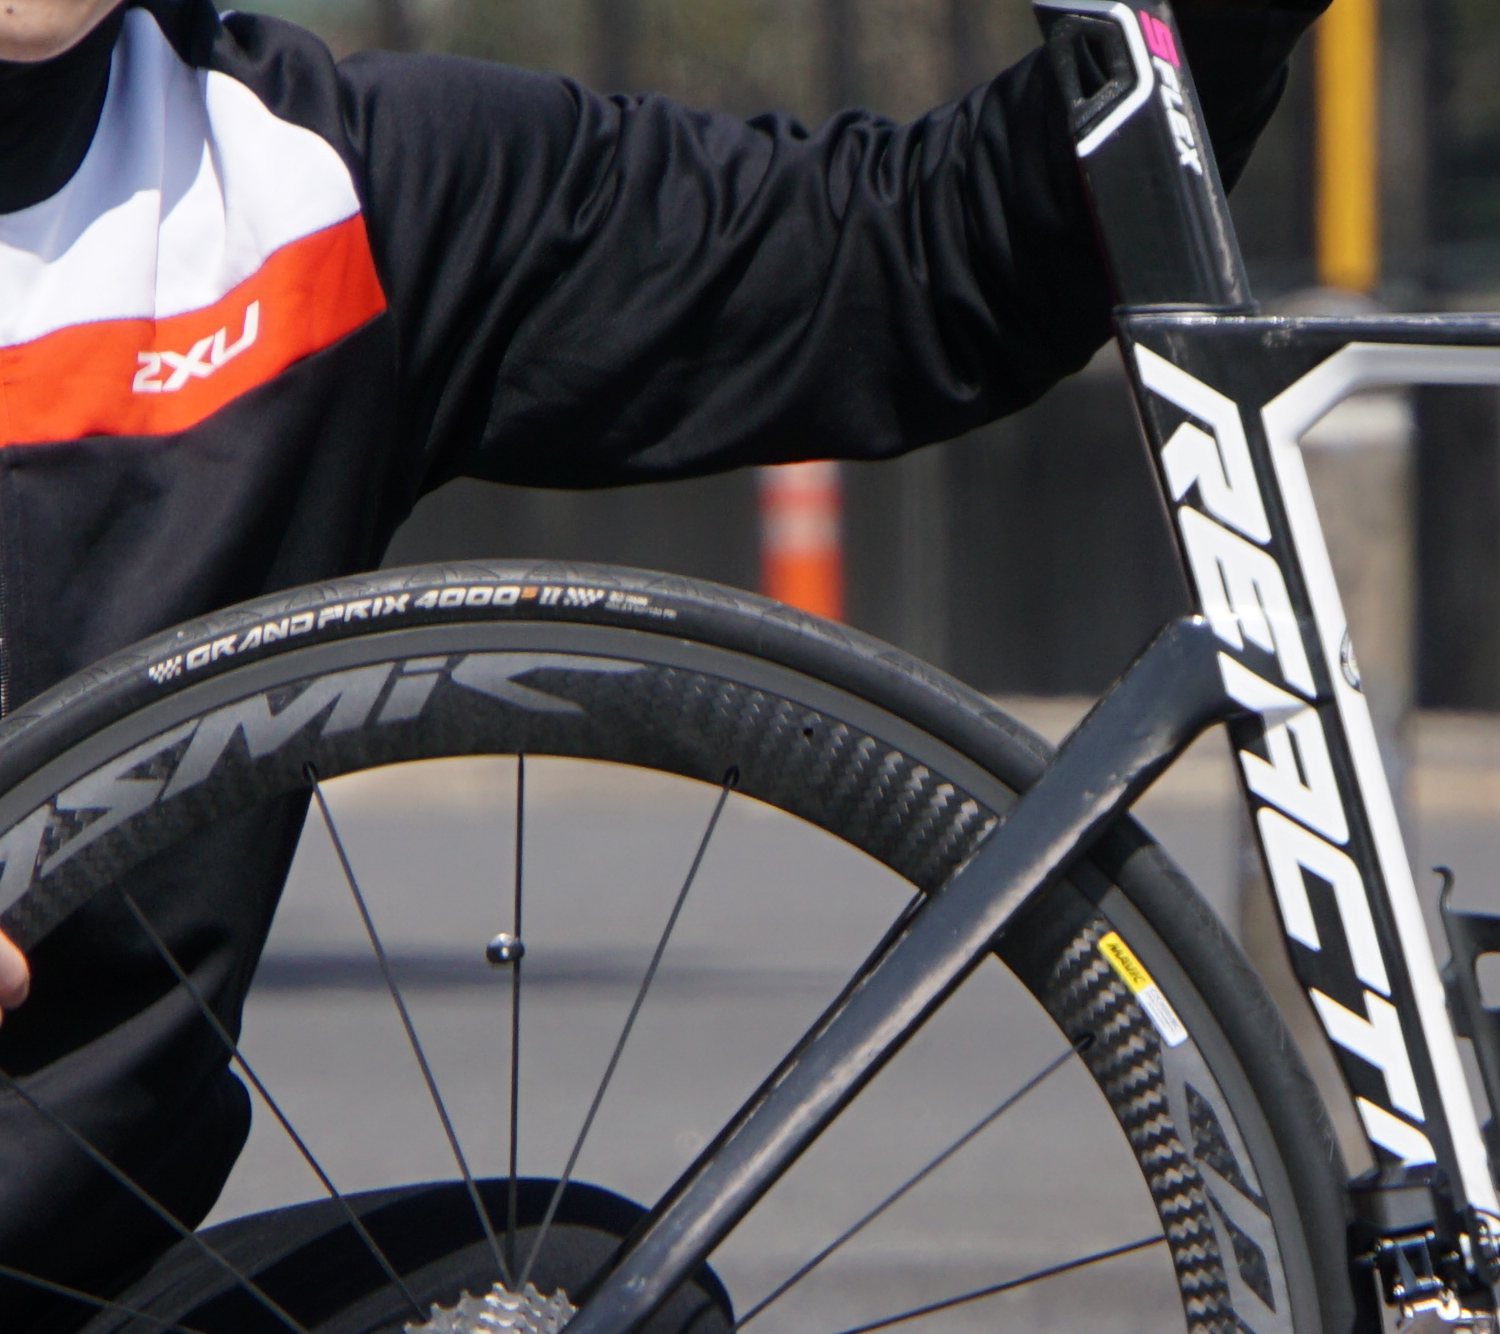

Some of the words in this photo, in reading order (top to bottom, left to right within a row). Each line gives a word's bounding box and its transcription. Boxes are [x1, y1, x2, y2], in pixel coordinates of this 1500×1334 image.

[132, 299, 261, 394] 2XU
[185, 611, 314, 672] GRAND
[317, 589, 409, 631] PRIX
[1106, 938, 1145, 986] MAVIC
